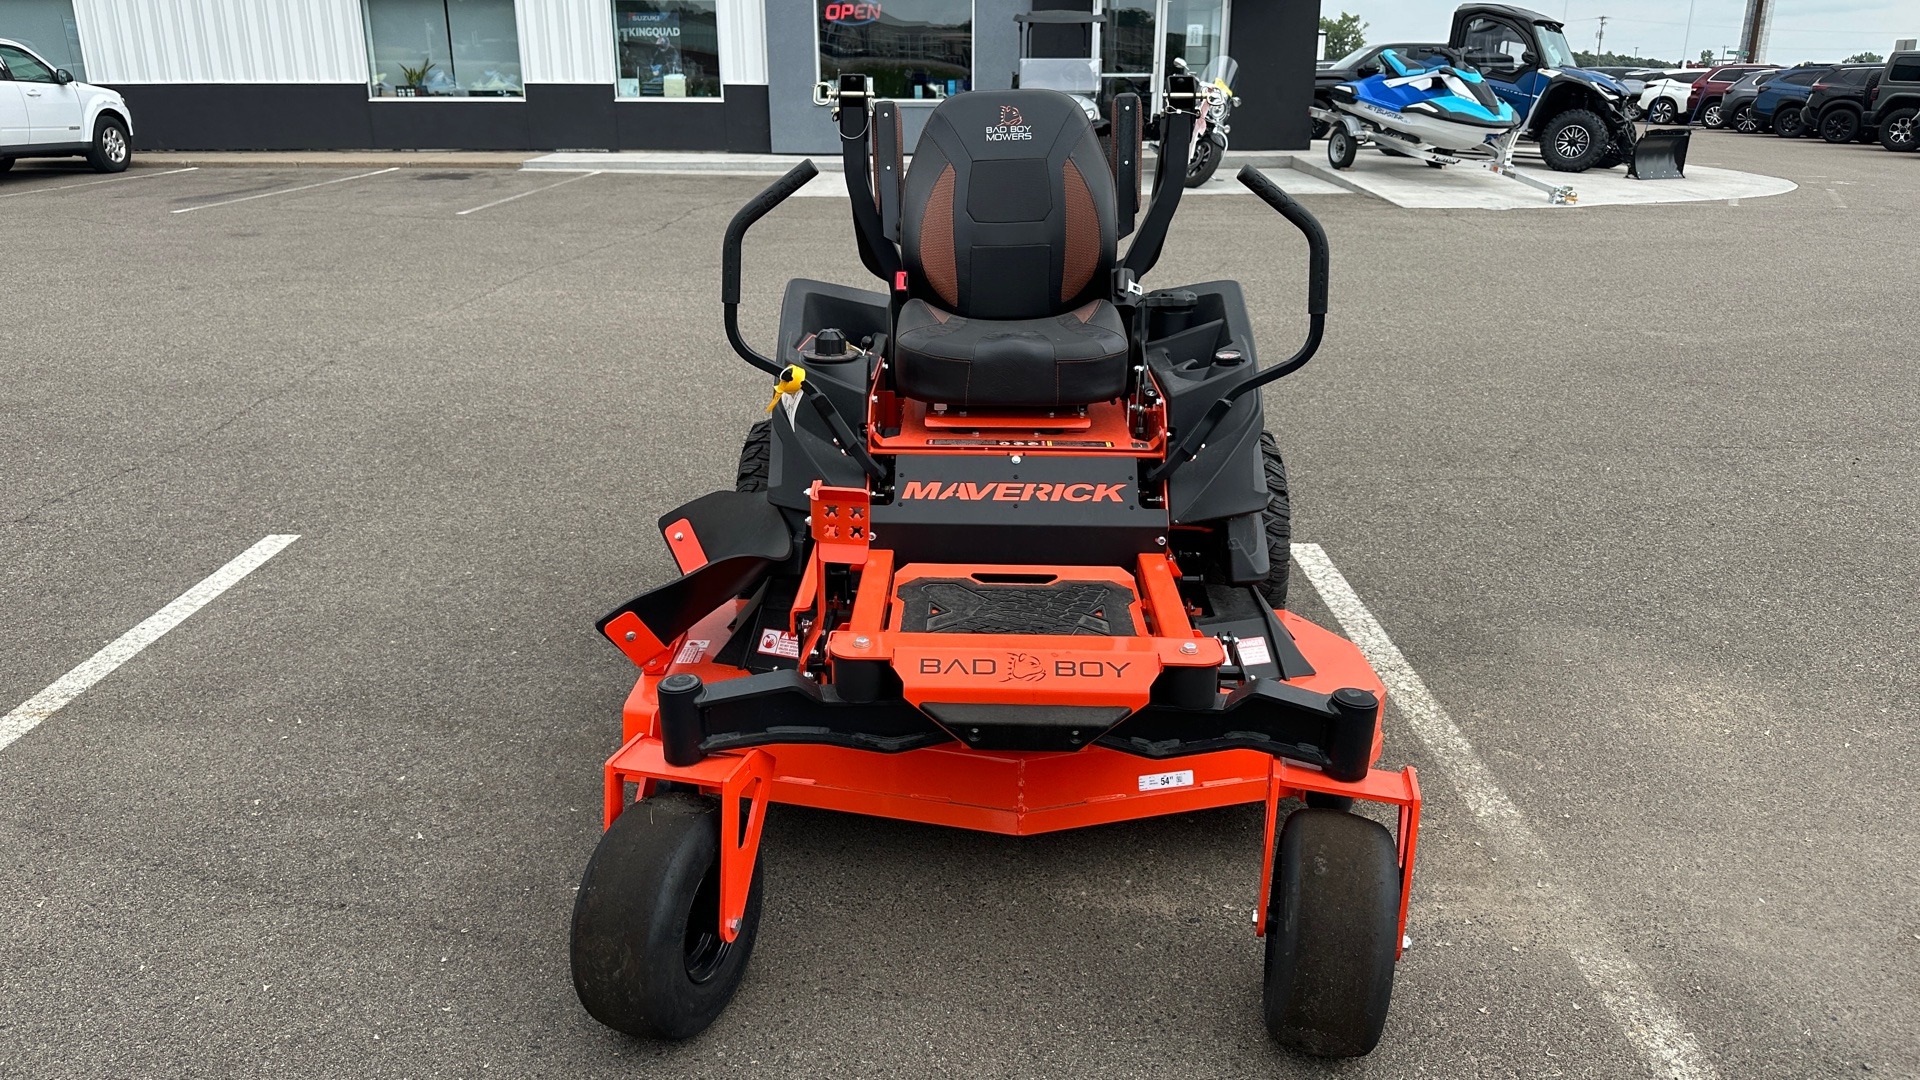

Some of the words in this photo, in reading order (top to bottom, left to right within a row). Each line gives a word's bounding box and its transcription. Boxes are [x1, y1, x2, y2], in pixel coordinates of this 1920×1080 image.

[825, 3, 882, 20] OPEN
[629, 27, 680, 37] KINGQUAD
[985, 126, 1007, 134] BAD
[1010, 125, 1031, 133] BOY
[986, 133, 1032, 141] MOWERS
[901, 481, 1128, 502] MAVERICK
[920, 658, 997, 675] BAD
[1055, 660, 1131, 678] BOY
